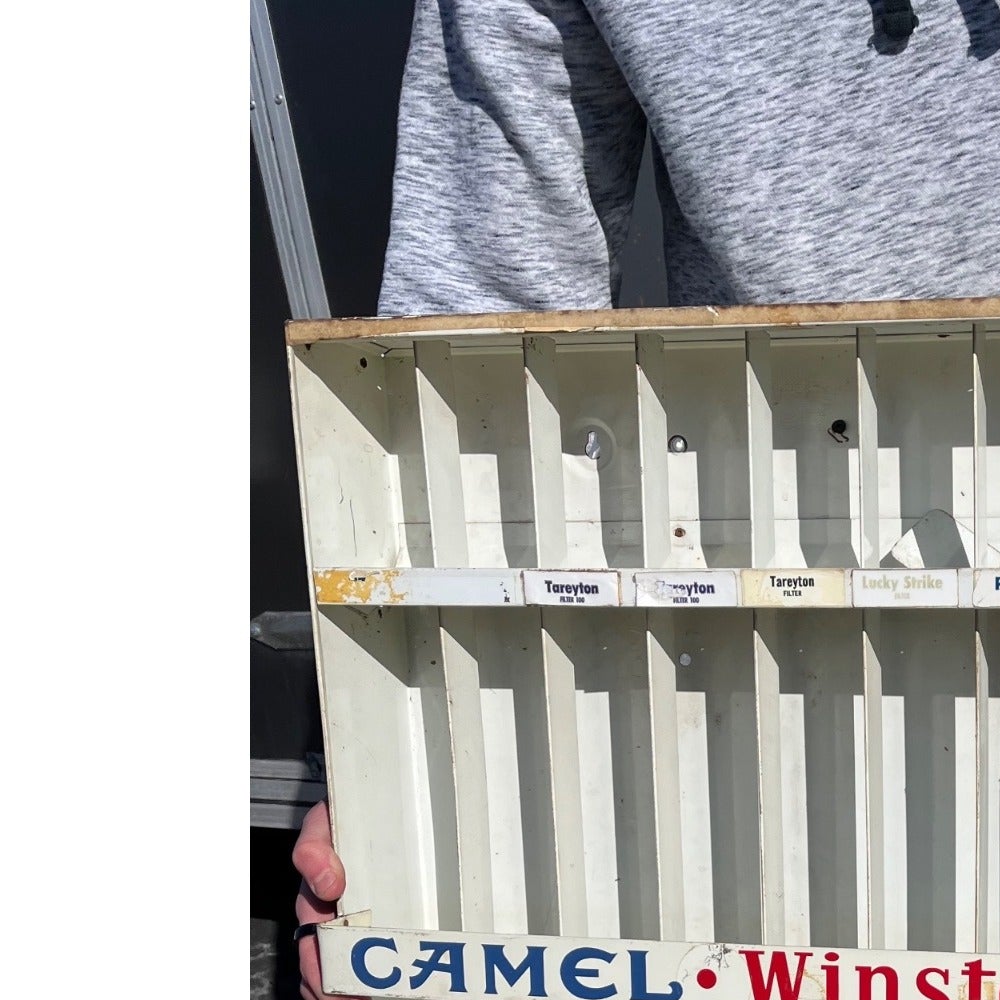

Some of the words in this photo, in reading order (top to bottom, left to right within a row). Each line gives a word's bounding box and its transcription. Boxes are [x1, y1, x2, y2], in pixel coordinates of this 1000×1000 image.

[544, 579, 599, 596] Tareyton
[769, 575, 815, 590] Tareyton
[862, 574, 898, 592] Lucky
[903, 573, 943, 590] Strike
[783, 590, 803, 598] FILTER
